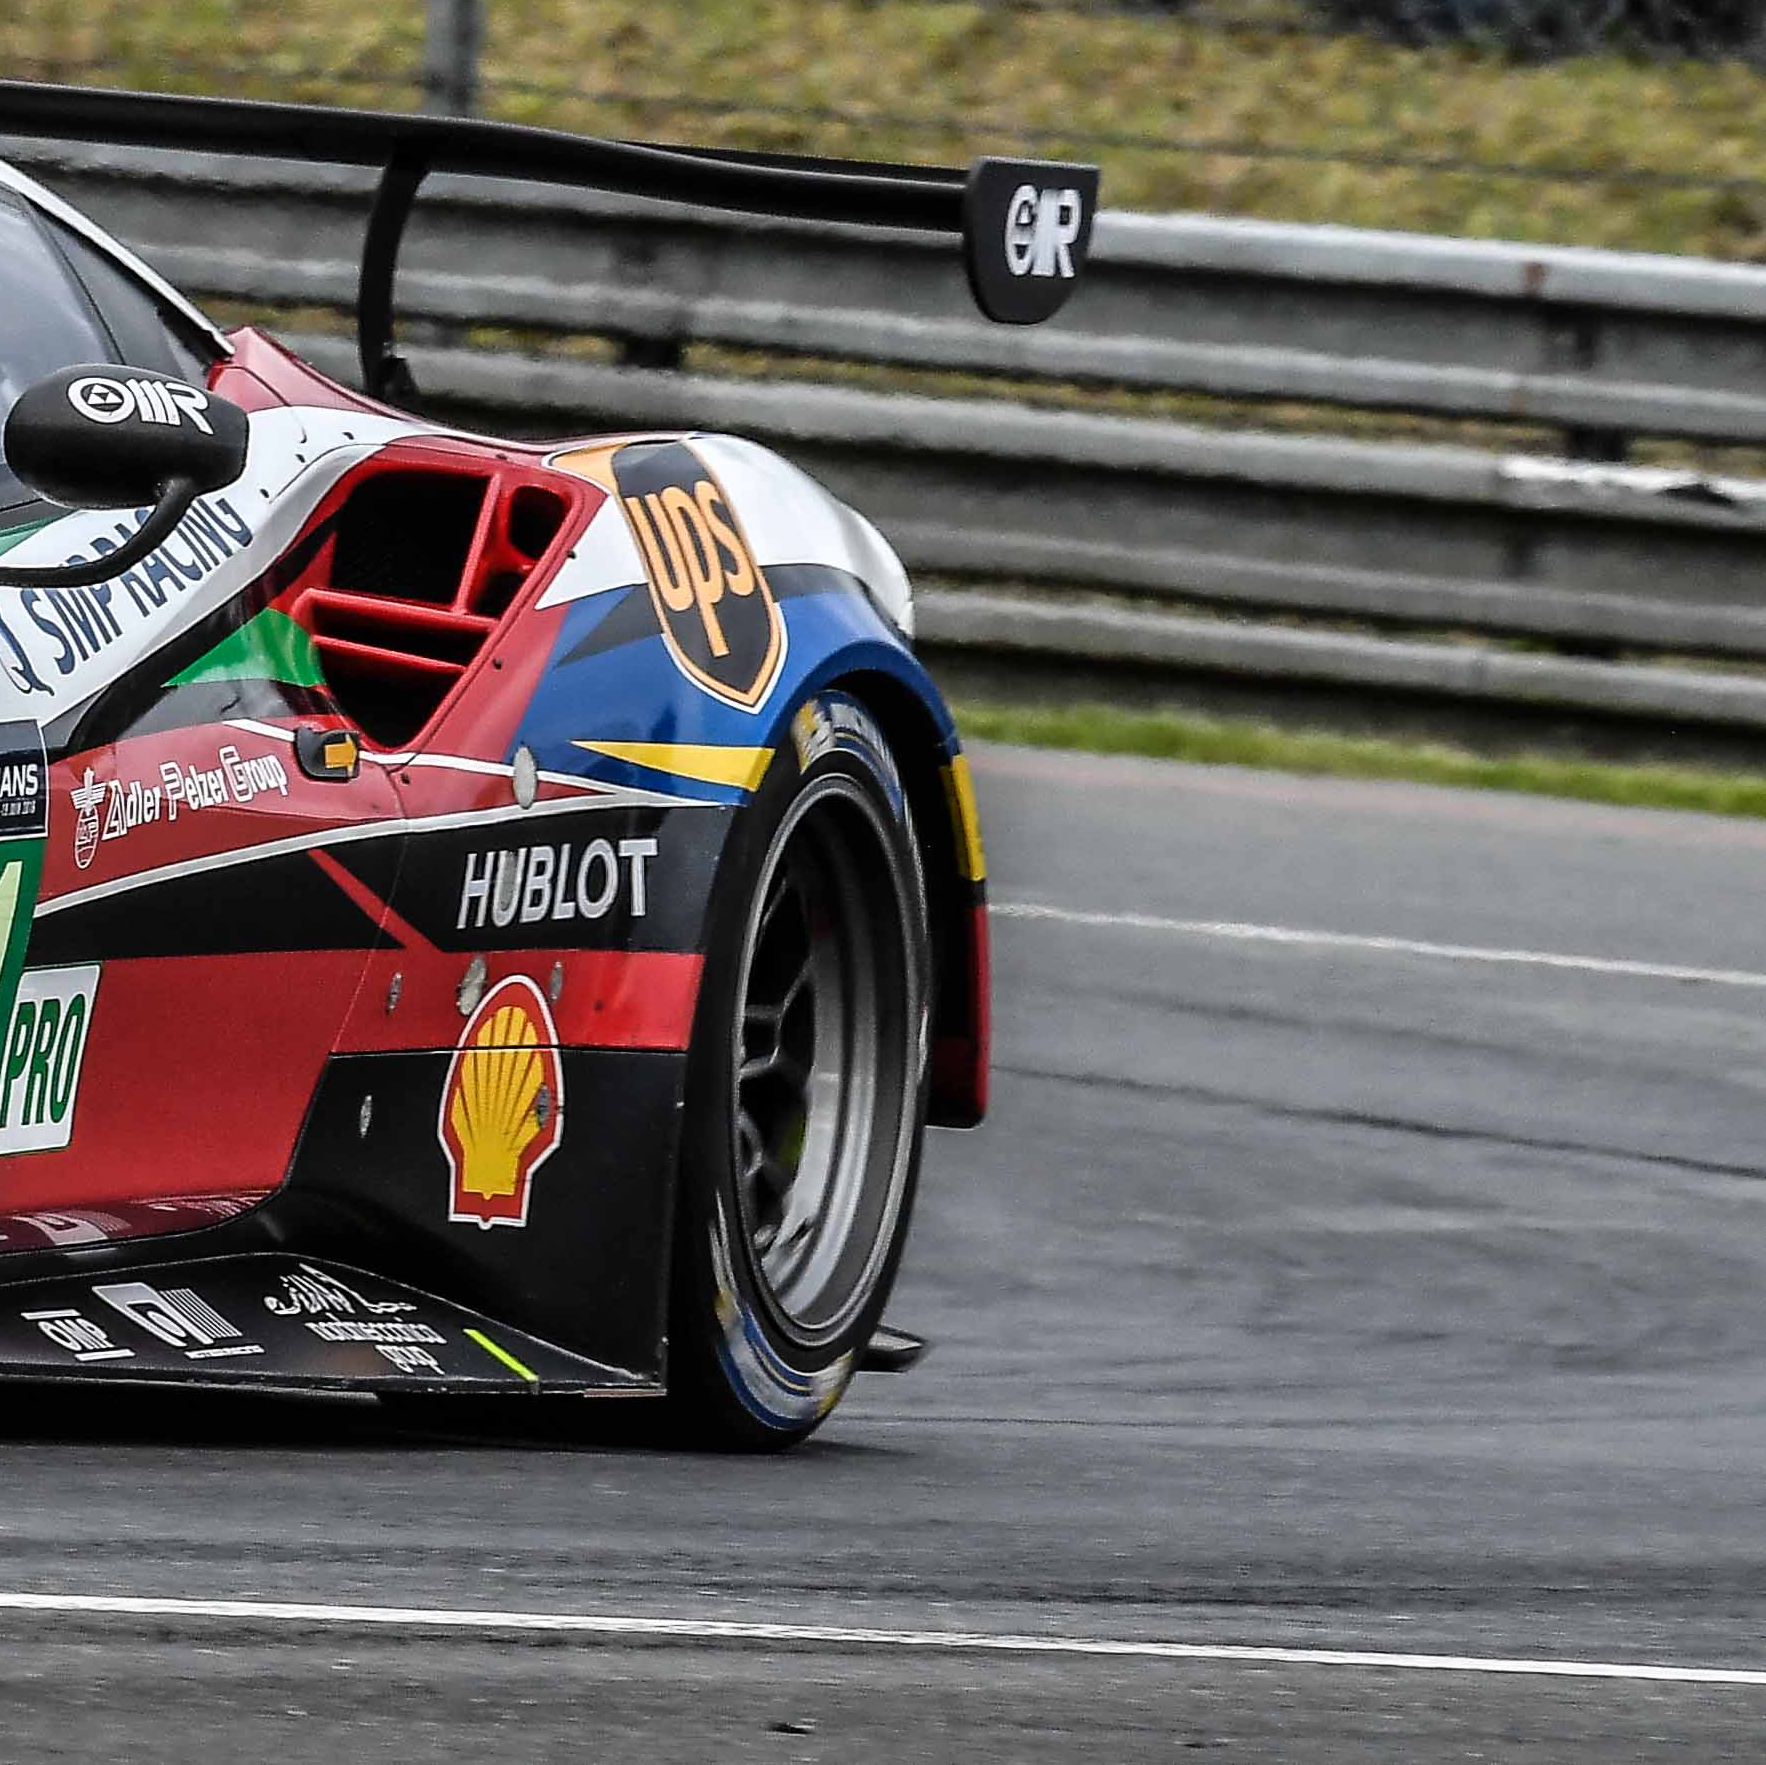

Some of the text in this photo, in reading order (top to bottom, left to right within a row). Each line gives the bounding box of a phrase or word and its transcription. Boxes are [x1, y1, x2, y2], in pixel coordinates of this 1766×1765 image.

[625, 481, 757, 658] ups
[100, 779, 161, 842] Adler
[159, 761, 228, 822] Pelzer
[218, 744, 290, 803] Group
[457, 838, 659, 929] HUBLOT
